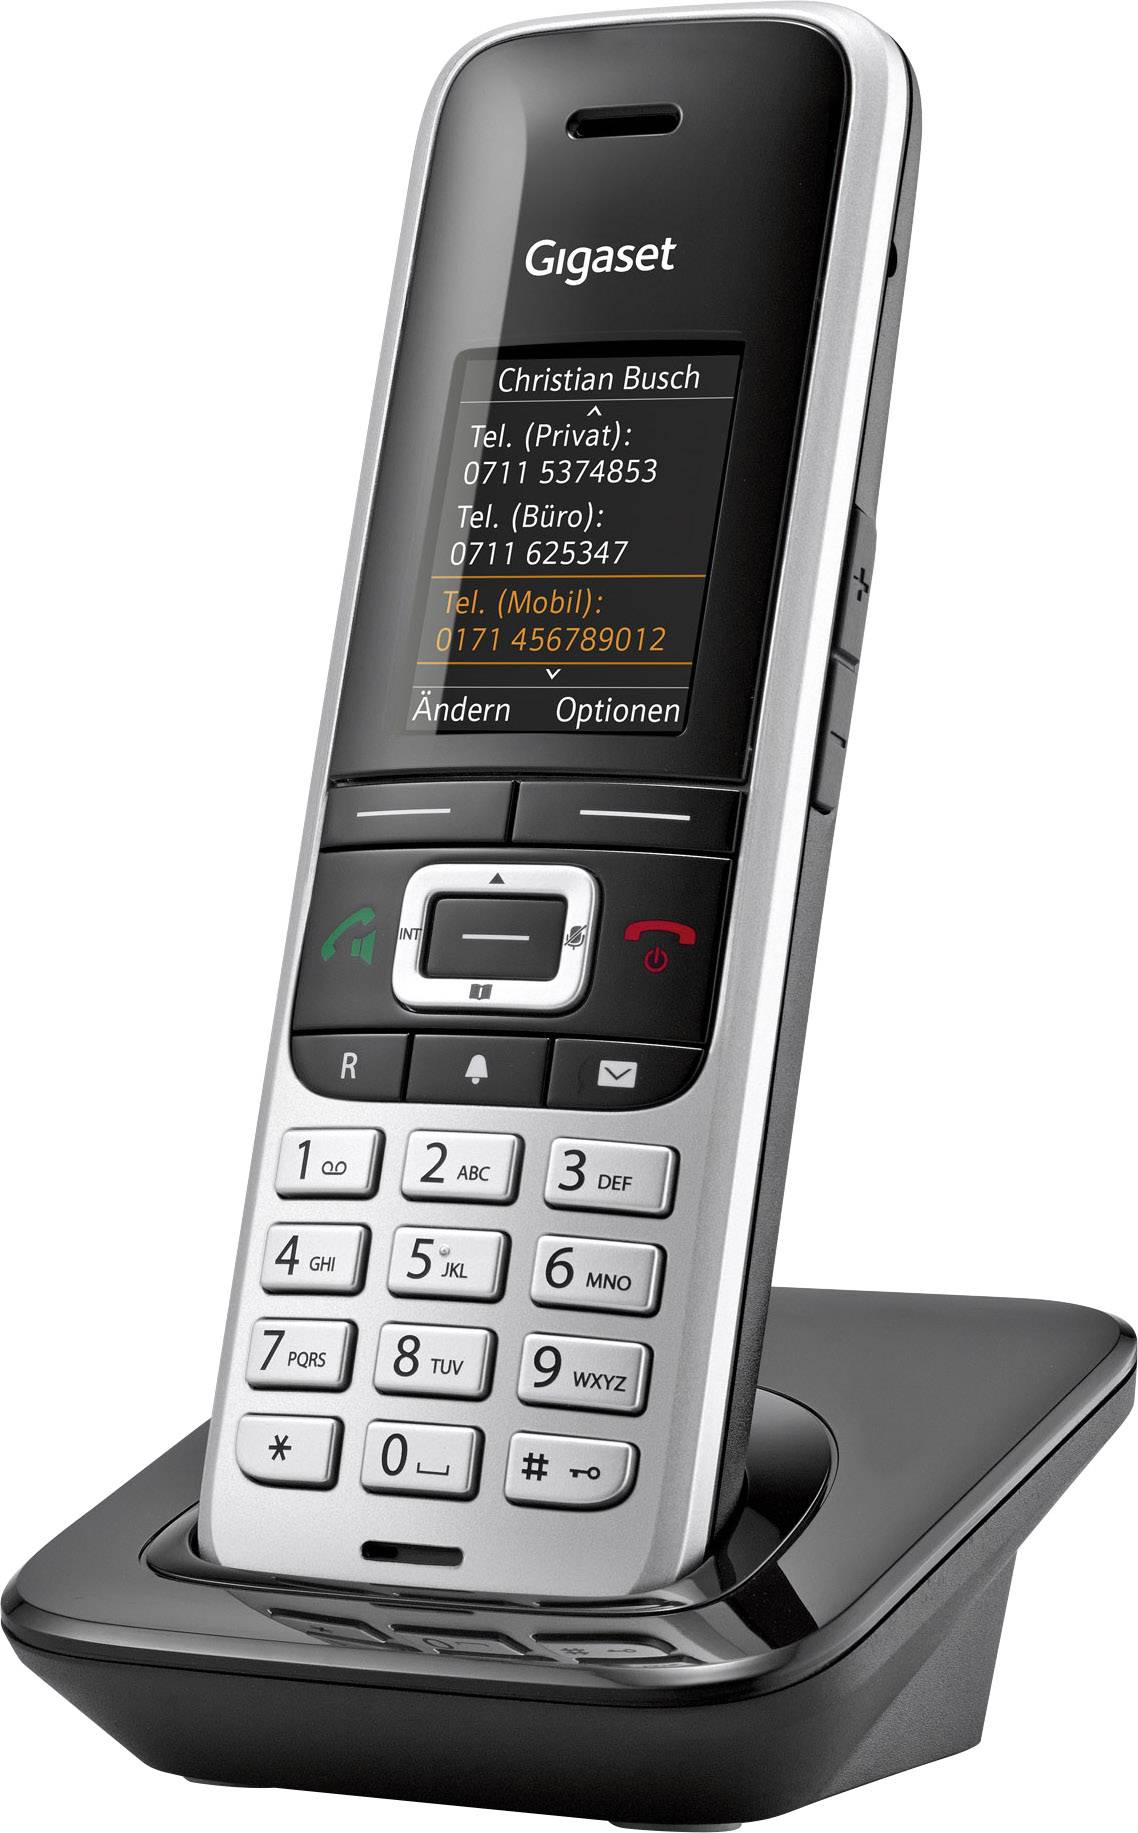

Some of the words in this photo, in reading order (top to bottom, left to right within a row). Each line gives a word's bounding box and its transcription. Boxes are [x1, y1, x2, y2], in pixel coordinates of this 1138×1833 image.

[525, 237, 678, 286] Gigaset
[498, 366, 614, 393] Christian
[623, 363, 700, 391] Busch
[471, 423, 512, 449] Tel.
[525, 420, 632, 453] (Privat):
[464, 460, 527, 485] 0711
[539, 458, 658, 485] 5374853
[457, 503, 499, 529] Tel.
[512, 501, 604, 534] (Büro):
[450, 541, 514, 566] 0711
[526, 540, 629, 566] 625347
[444, 589, 484, 615] Tel.
[497, 587, 603, 619] (Mobil):
[436, 627, 500, 652] 0171
[511, 626, 666, 652] 456789012
[411, 690, 511, 722] Ändern
[556, 696, 680, 730] Optionen
[400, 927, 422, 941] INT
[340, 1051, 358, 1080] R
[298, 1139, 311, 1180] 1
[419, 1141, 448, 1184] 2
[456, 1164, 491, 1182] ABC
[557, 1149, 587, 1192] 3
[597, 1173, 633, 1192] DEF
[274, 1234, 300, 1276] 4
[309, 1255, 336, 1272] GHI
[406, 1237, 435, 1280] 5
[440, 1261, 468, 1279] JKL
[545, 1246, 575, 1289] 6
[585, 1271, 632, 1292] MNO
[259, 1329, 286, 1371] 7
[287, 1351, 327, 1369] PQRS
[393, 1334, 421, 1378] 8
[430, 1357, 465, 1376] TUV
[533, 1345, 562, 1388] 9
[573, 1370, 628, 1393] WXYZ
[381, 1432, 408, 1477] 0
